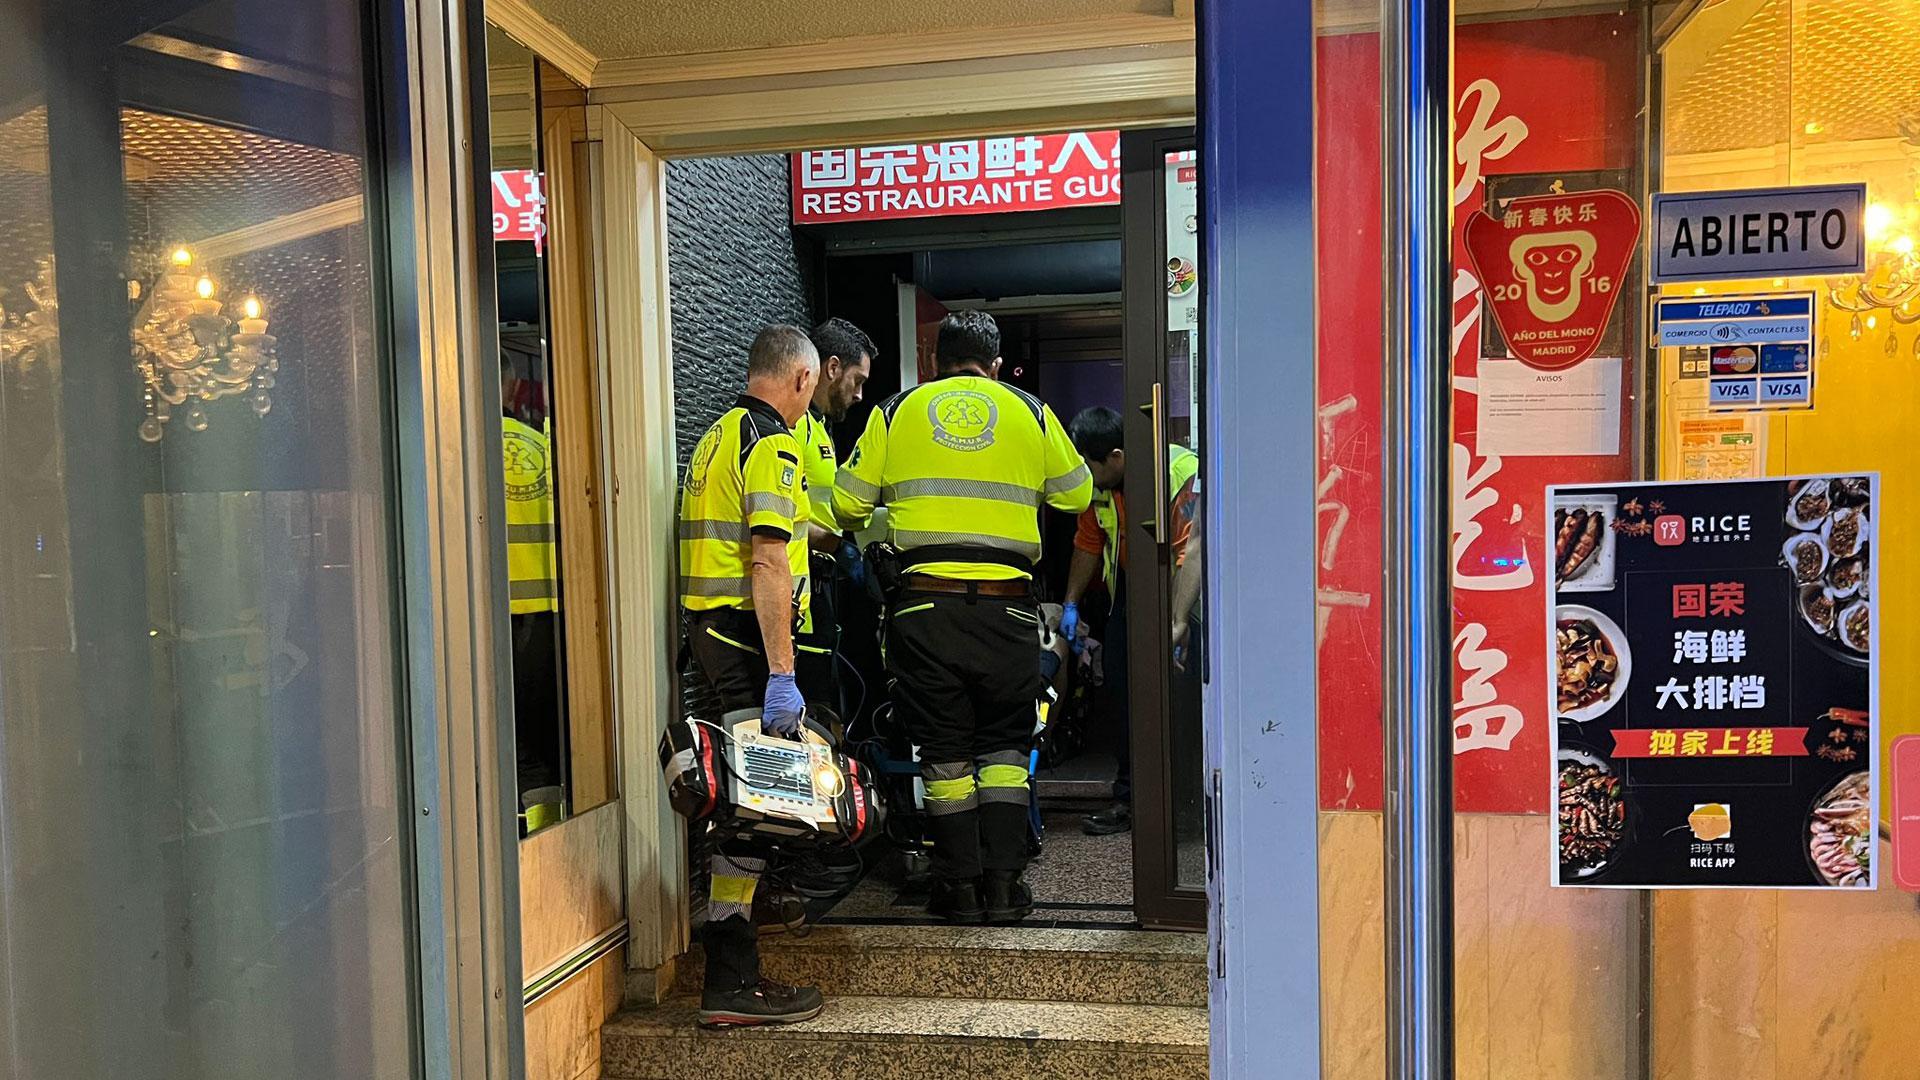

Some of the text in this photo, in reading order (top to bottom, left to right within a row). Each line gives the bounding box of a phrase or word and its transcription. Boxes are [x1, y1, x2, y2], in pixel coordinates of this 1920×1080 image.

[803, 179, 1052, 215] RESTRAURANTE
[1504, 203, 1598, 229] 新春快乐
[1671, 208, 1846, 258] ABIERTO
[1494, 276, 1611, 300] 20 16
[1699, 303, 1750, 316] TELEPAGO
[1513, 327, 1595, 341] AÑO DEL MONO
[1748, 326, 1805, 334] CONTACTLESS
[1533, 345, 1576, 356] MADRID
[1718, 385, 1750, 396] VISA
[1768, 384, 1801, 395] VISA
[1692, 515, 1750, 532] RICE
[1673, 582, 1744, 618] 国荣
[1673, 629, 1746, 664] 海鲜
[1656, 675, 1765, 710] 大排档
[1649, 729, 1774, 756] 独家上线
[1690, 843, 1735, 856] 扫码下载
[1690, 858, 1735, 868] RICE APP
